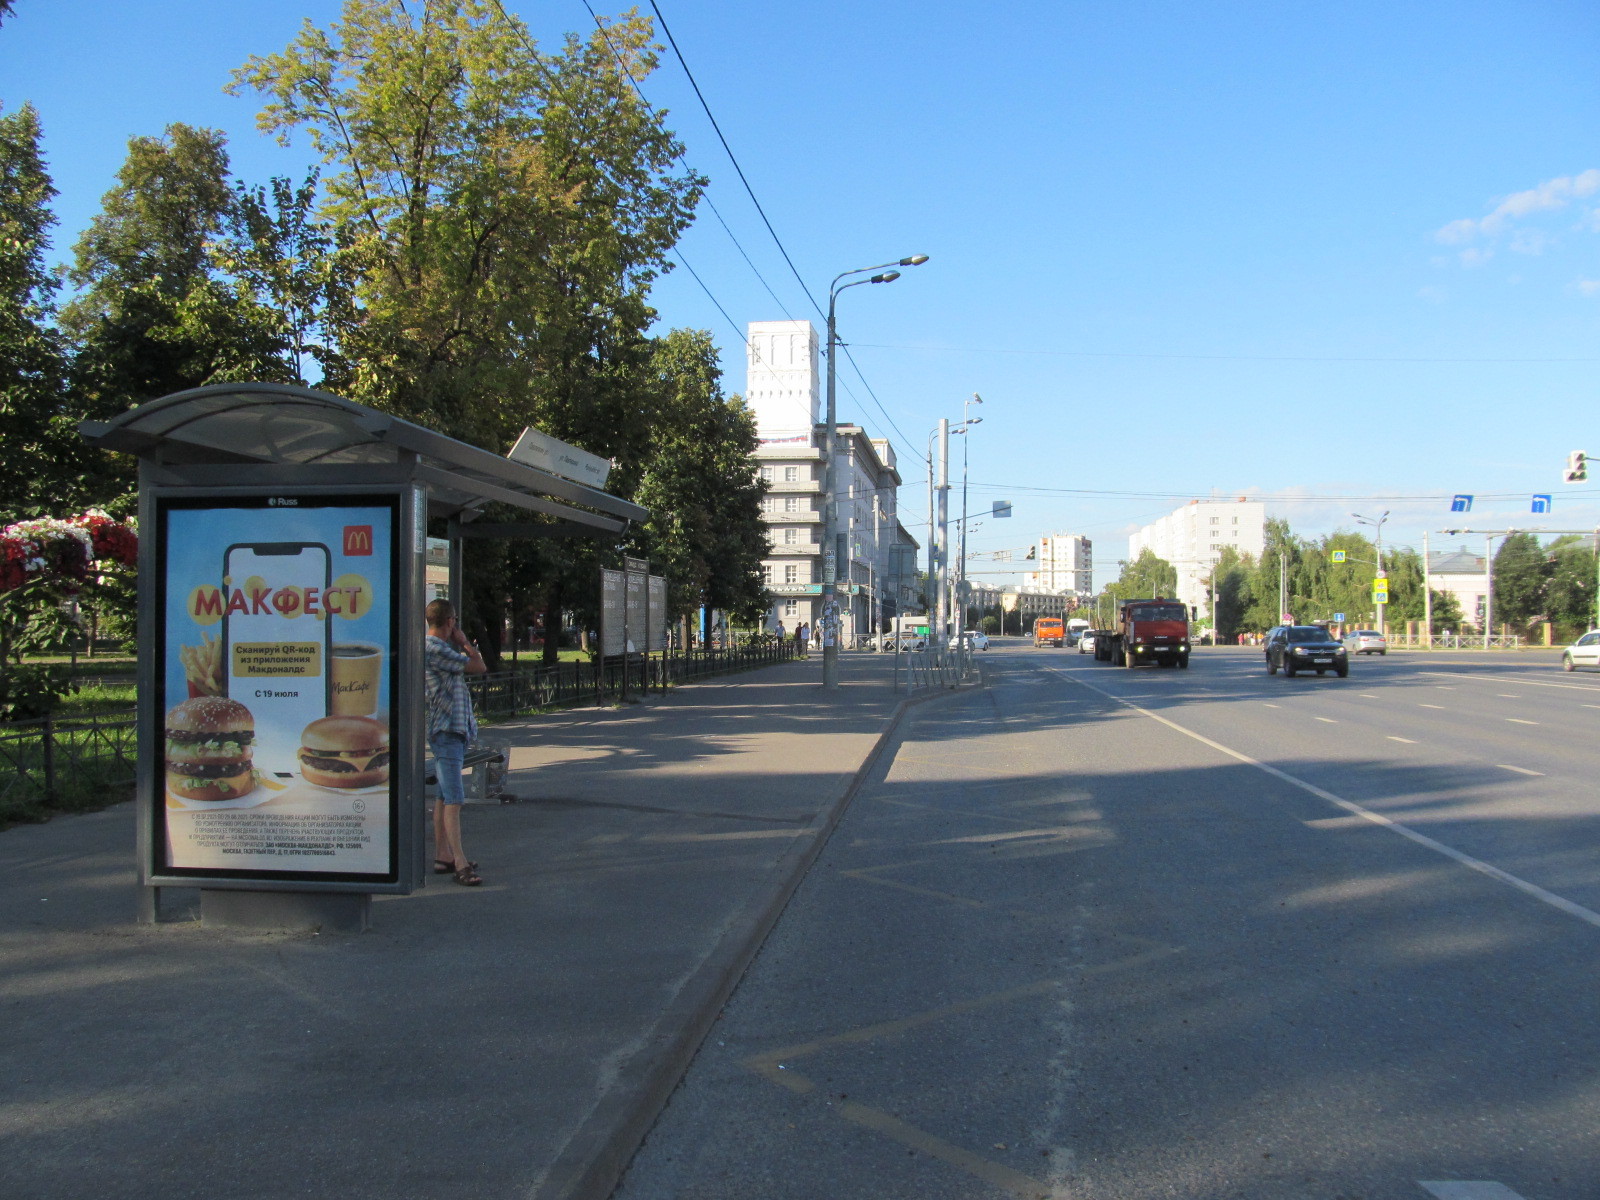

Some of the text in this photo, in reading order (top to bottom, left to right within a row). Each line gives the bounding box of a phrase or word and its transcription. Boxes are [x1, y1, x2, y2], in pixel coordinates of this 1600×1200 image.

[277, 498, 298, 506] Russ
[194, 586, 362, 615] МАКФЕСТ
[236, 645, 316, 656] Сканируй QR-код
[253, 656, 311, 666] приложения
[247, 664, 305, 675] Макдоналдс
[255, 690, 299, 698] С 19 июля
